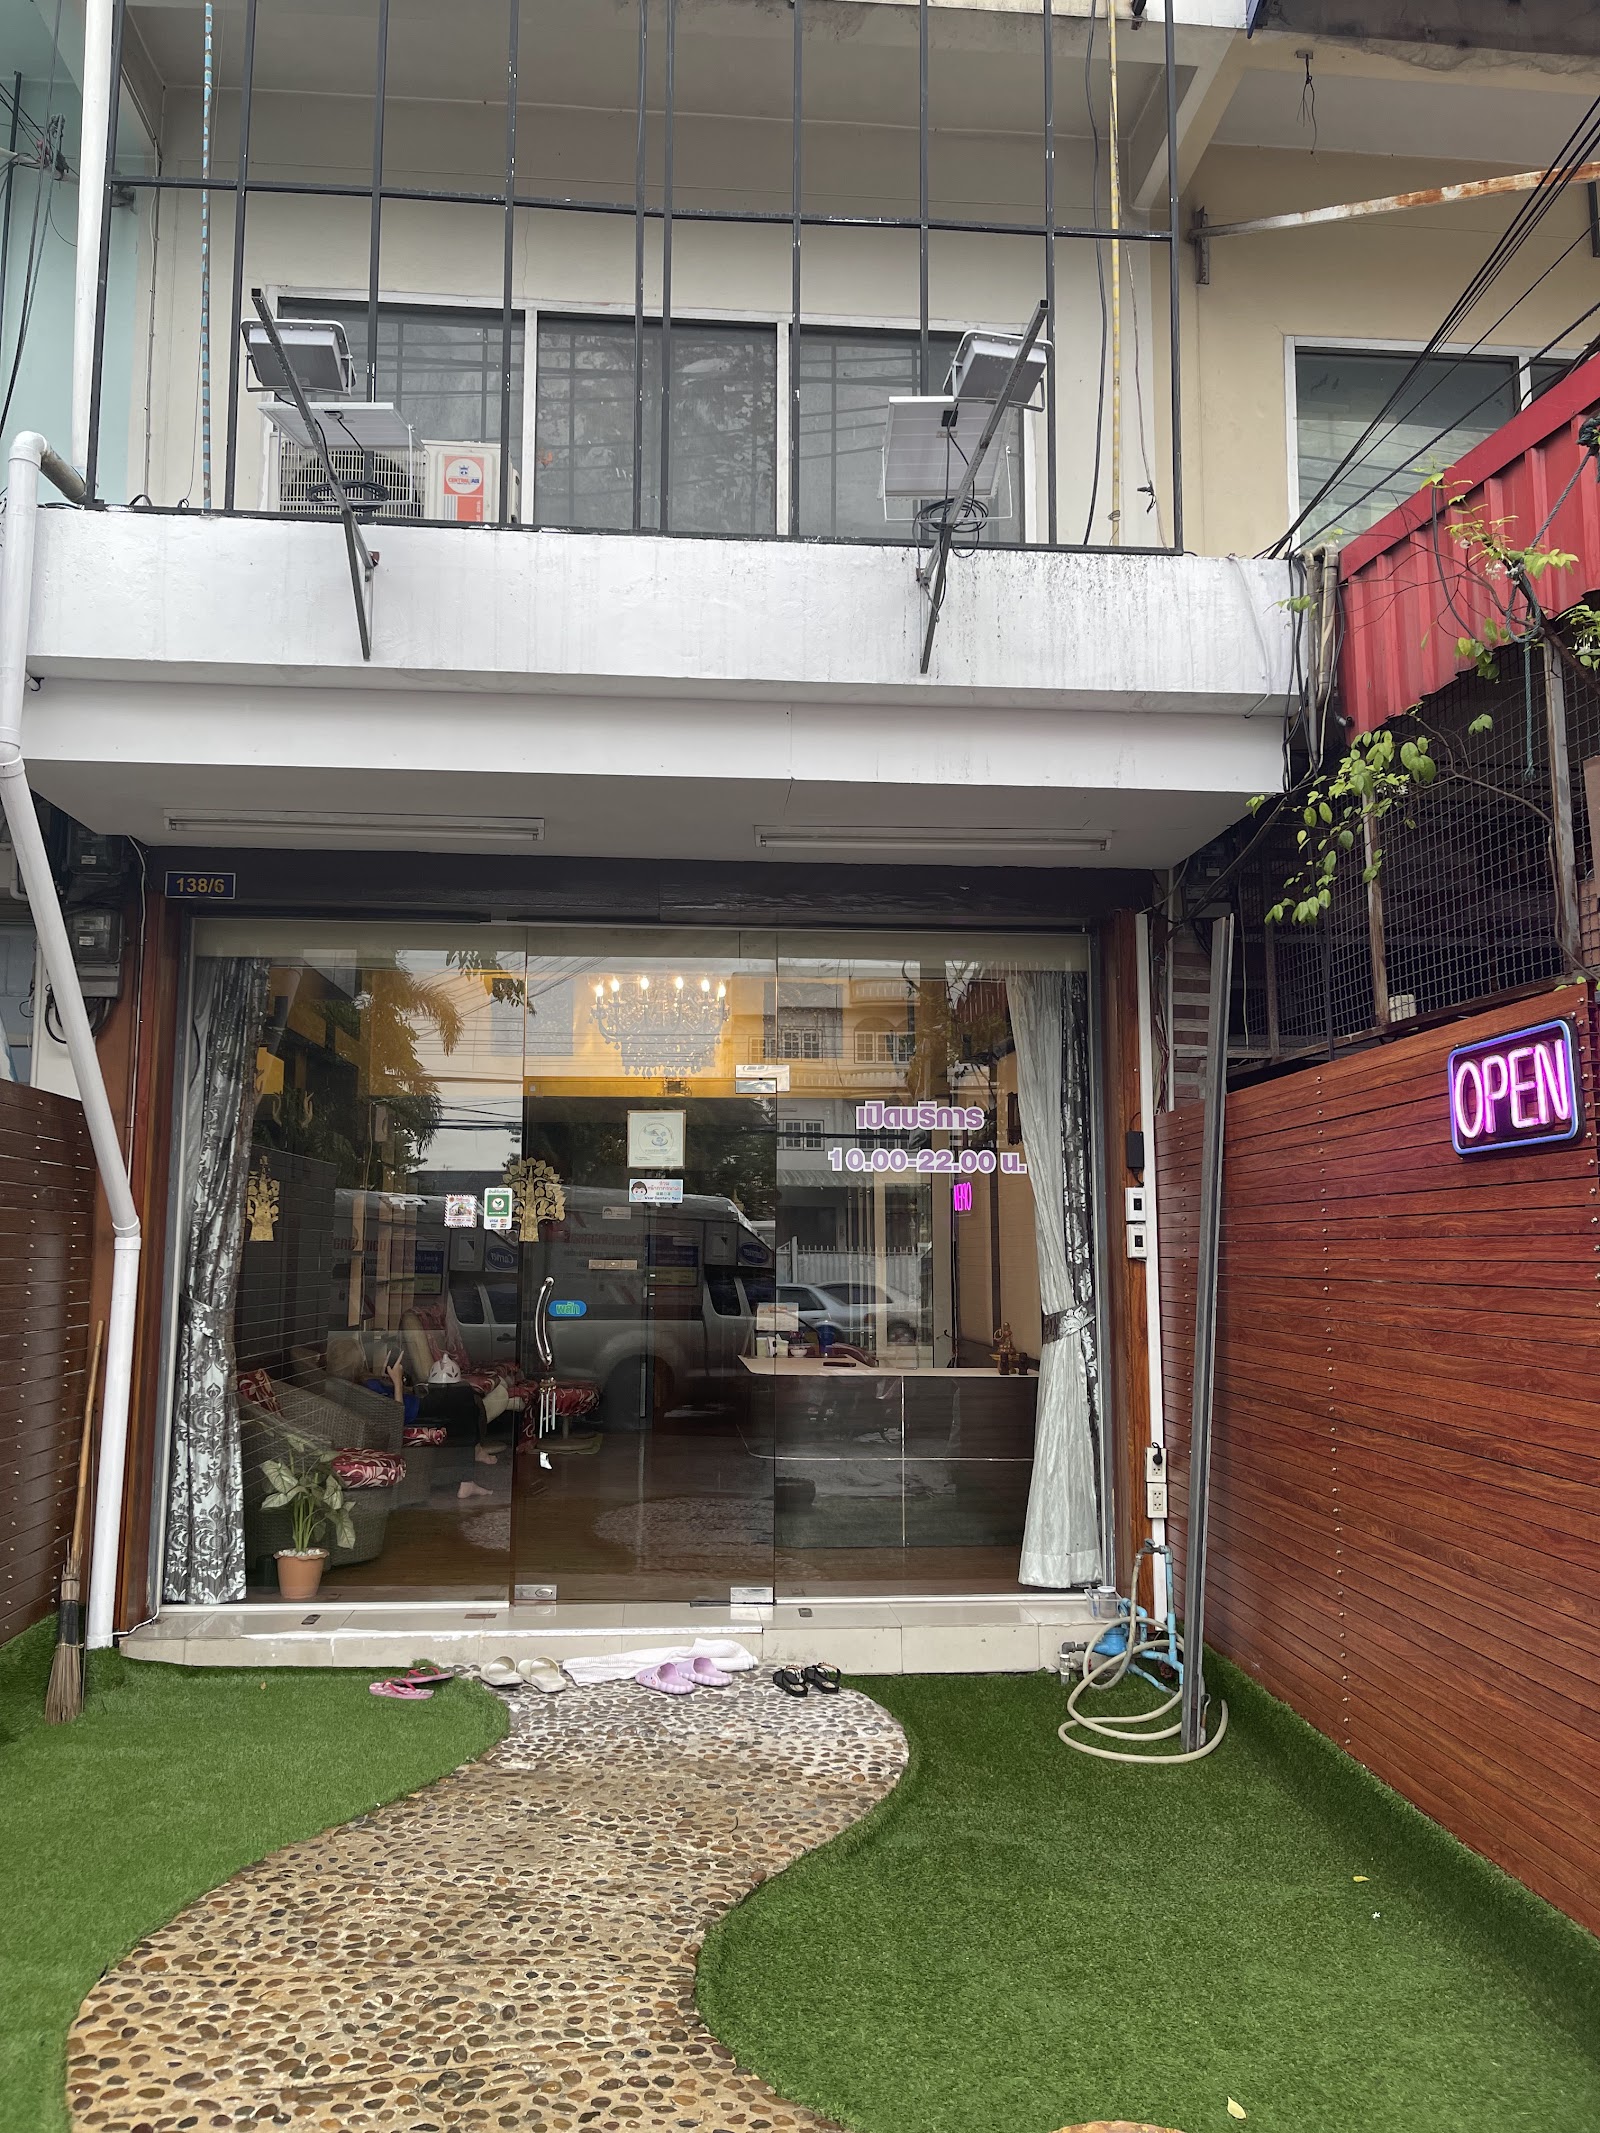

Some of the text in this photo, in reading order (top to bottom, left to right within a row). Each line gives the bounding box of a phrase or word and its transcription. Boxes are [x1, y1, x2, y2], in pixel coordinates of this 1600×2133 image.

[176, 877, 225, 893] 138/6
[1455, 1039, 1571, 1138] OPEN
[856, 1101, 985, 1130] เปิดบริการ
[827, 1147, 1027, 1174] 10.00-22.00 น.
